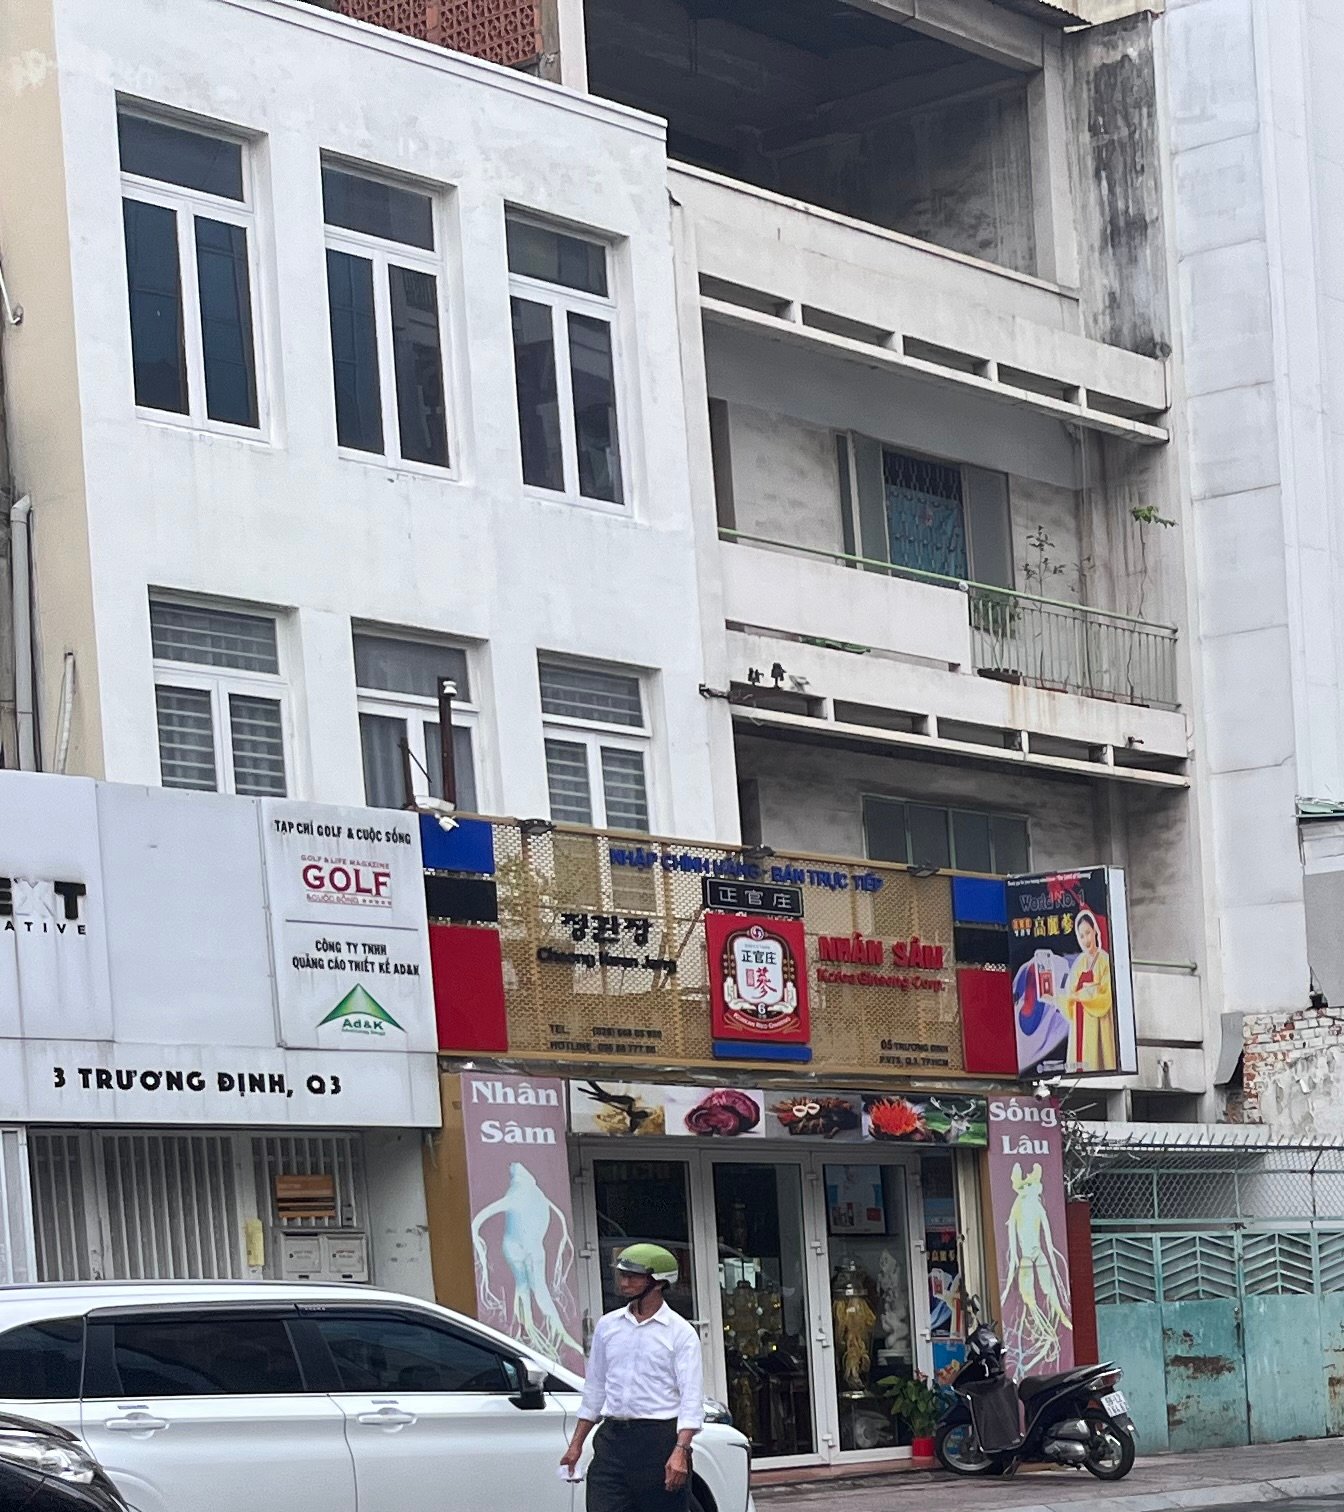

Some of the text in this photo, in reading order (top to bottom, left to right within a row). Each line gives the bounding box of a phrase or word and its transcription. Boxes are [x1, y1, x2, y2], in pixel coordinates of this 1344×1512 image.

[274, 819, 411, 845] TẠP CHÍ GOLF & CUỘC SỐNG
[302, 863, 391, 896] GOLF
[770, 864, 806, 884] BÁN
[807, 869, 849, 891] TRỰC
[718, 885, 793, 909] 正官庄
[1019, 892, 1054, 912] World
[315, 938, 387, 956] CÔNG TY TNHH
[741, 950, 777, 966] 正官庄
[818, 931, 944, 970] NHÂN SÂM
[292, 953, 420, 976] QUẢNG CÁO THIẾT KẾ AD&K
[817, 968, 855, 985] Korea
[857, 972, 910, 992] Ginseng
[342, 1018, 384, 1031] Ad&K
[53, 1067, 342, 1098] 3 TRƯƠNG ĐỊNH, Q3
[470, 1081, 559, 1106] Nhân
[989, 1097, 1058, 1128] Sống
[480, 1120, 556, 1145] Sâm
[1001, 1134, 1050, 1155] Lâu
